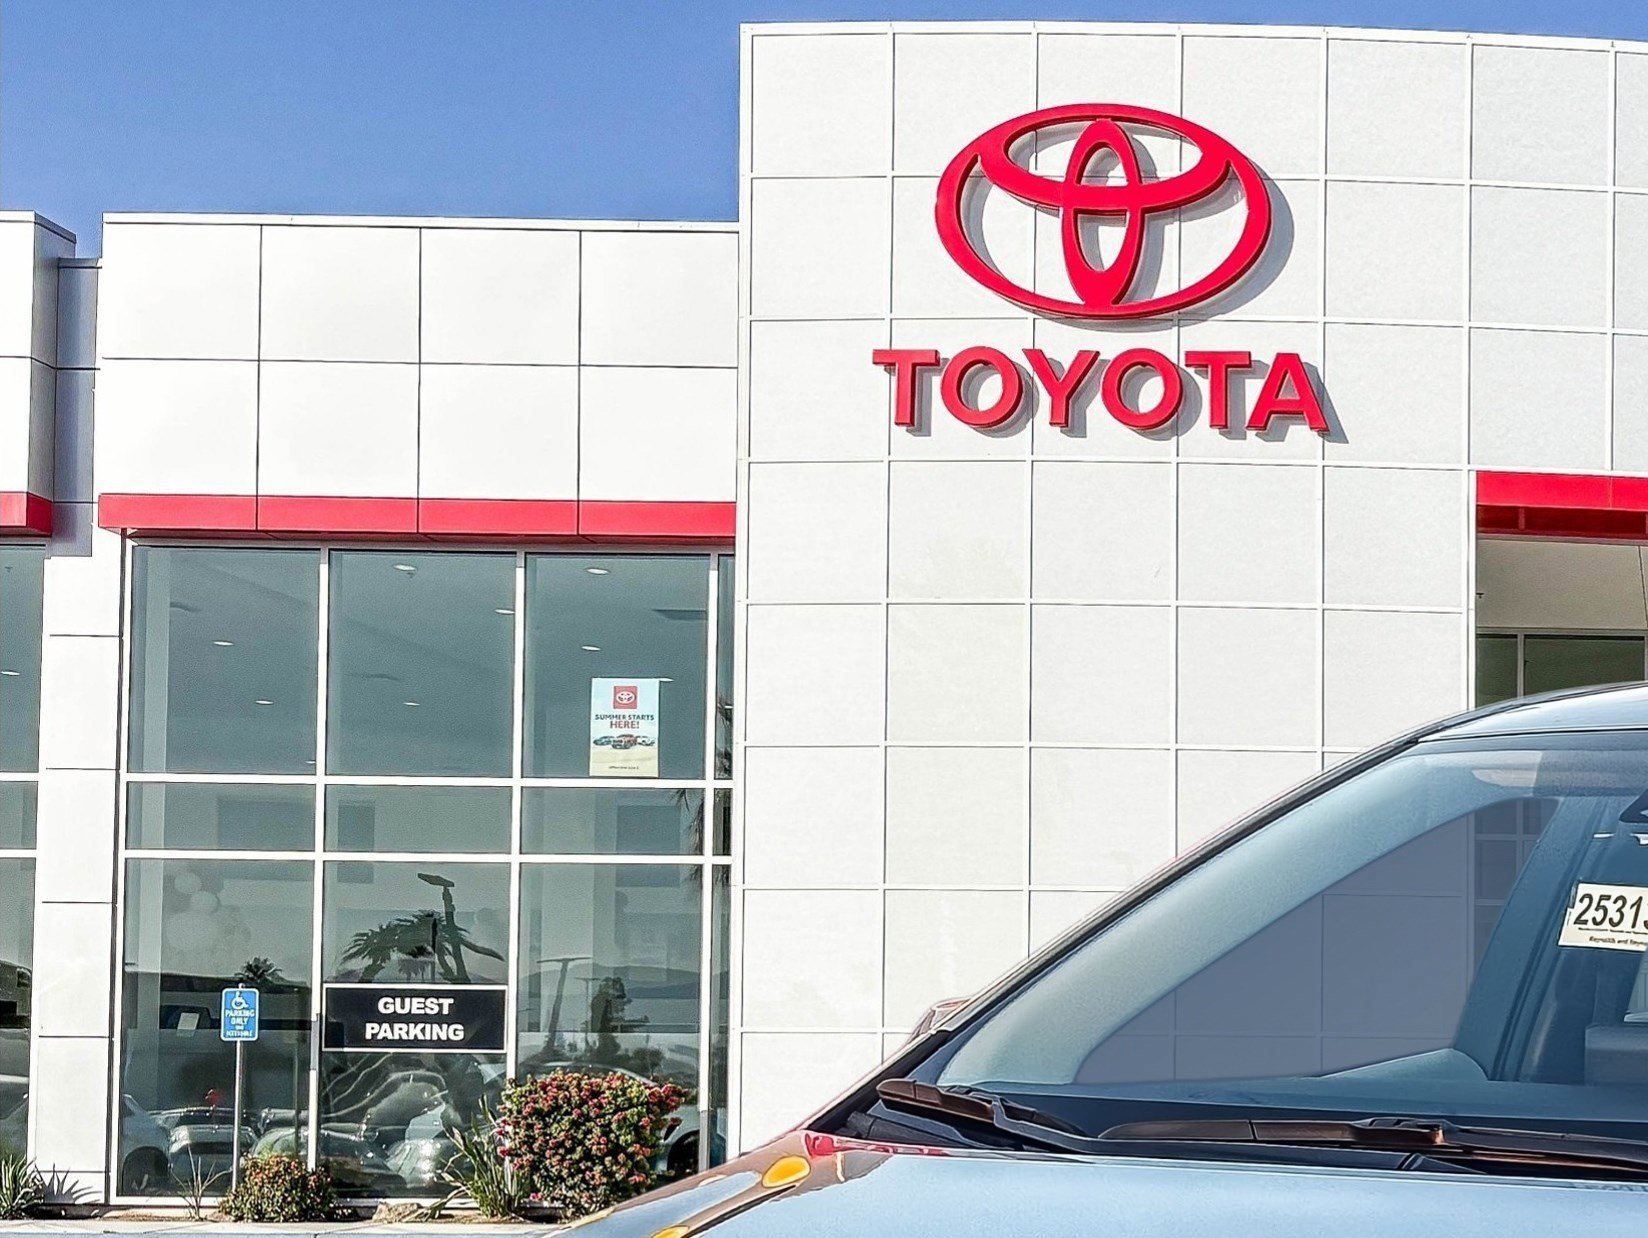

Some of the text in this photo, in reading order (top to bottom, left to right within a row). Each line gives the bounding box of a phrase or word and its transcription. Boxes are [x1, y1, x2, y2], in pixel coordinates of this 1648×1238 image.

[873, 346, 1329, 432] TOYOTA
[610, 720, 640, 729] HERE!
[377, 996, 454, 1015] GUEST
[365, 1022, 465, 1041] PARKING
